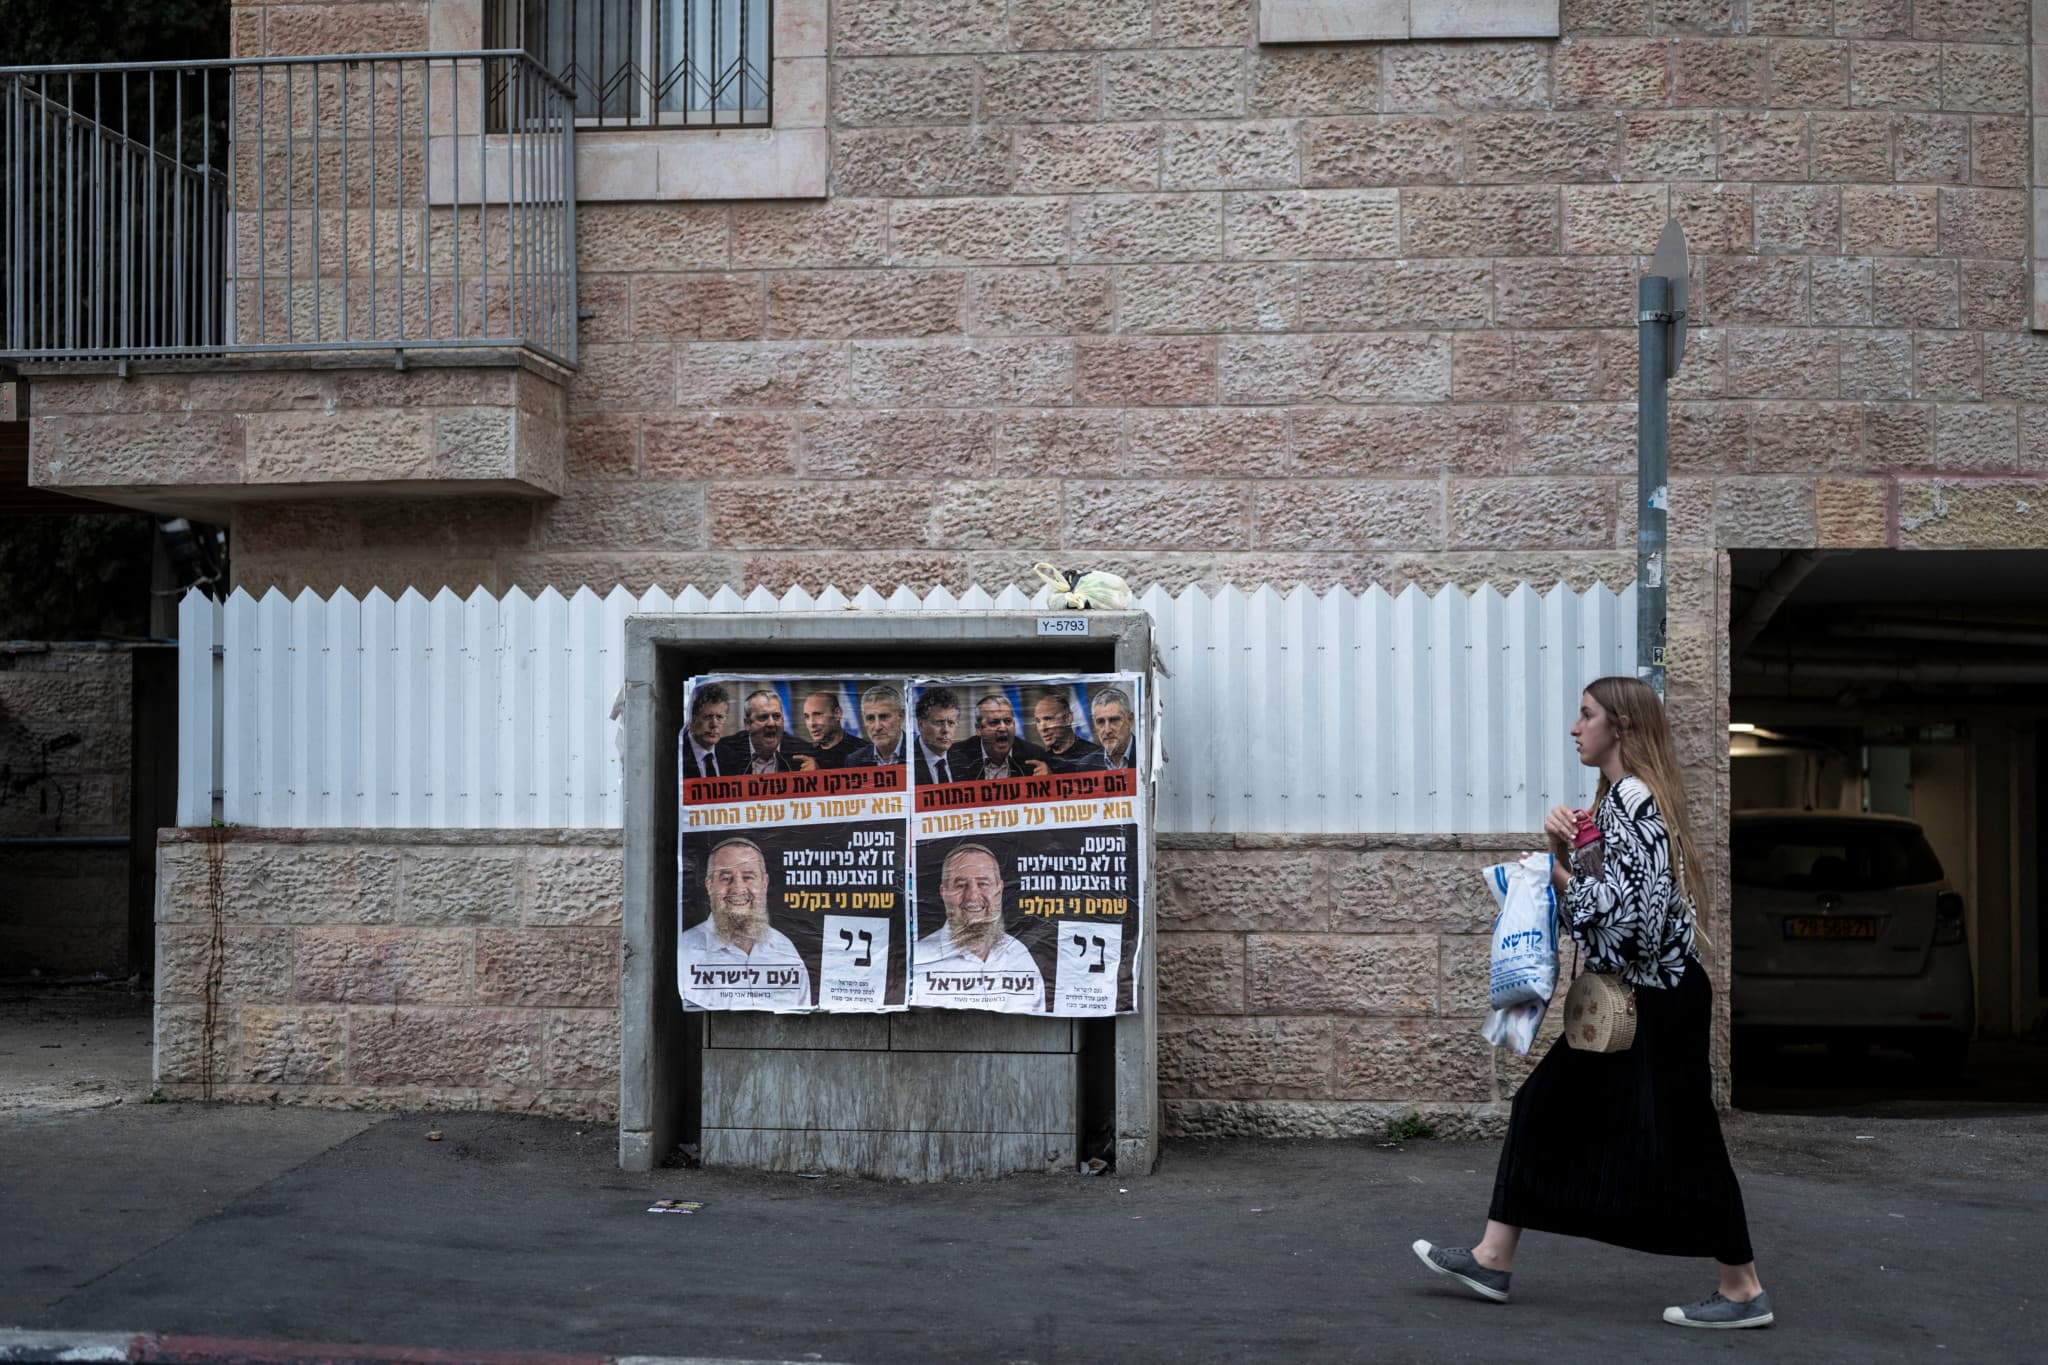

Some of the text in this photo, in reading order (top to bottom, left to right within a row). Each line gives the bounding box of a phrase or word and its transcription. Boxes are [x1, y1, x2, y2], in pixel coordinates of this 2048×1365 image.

[1042, 620, 1085, 631] Y-5793
[691, 770, 897, 800] הם יפרקו את עולם התורה
[923, 774, 1127, 807] הם יפרקו את עולם התורה
[689, 796, 902, 826] הוא ישמור על עולם התורה
[921, 801, 1133, 833] הוא ישמור על עולם התורה
[848, 831, 895, 850] הפעם,
[1080, 836, 1126, 855] הפעם,
[783, 848, 895, 866] זו לא פריווילגיה
[1017, 854, 1127, 872] זו לא פריווילגיה
[785, 870, 895, 886] זו הצבעת חובה
[1020, 875, 1127, 891] זו הצבעת חובה
[783, 890, 895, 912] שמים ני בקלפי
[1018, 896, 1128, 918] שמים ני בקלפי
[839, 927, 873, 967] ני
[1073, 933, 1106, 973] ני
[690, 964, 760, 985] לישראל
[925, 971, 995, 991] לישראל
